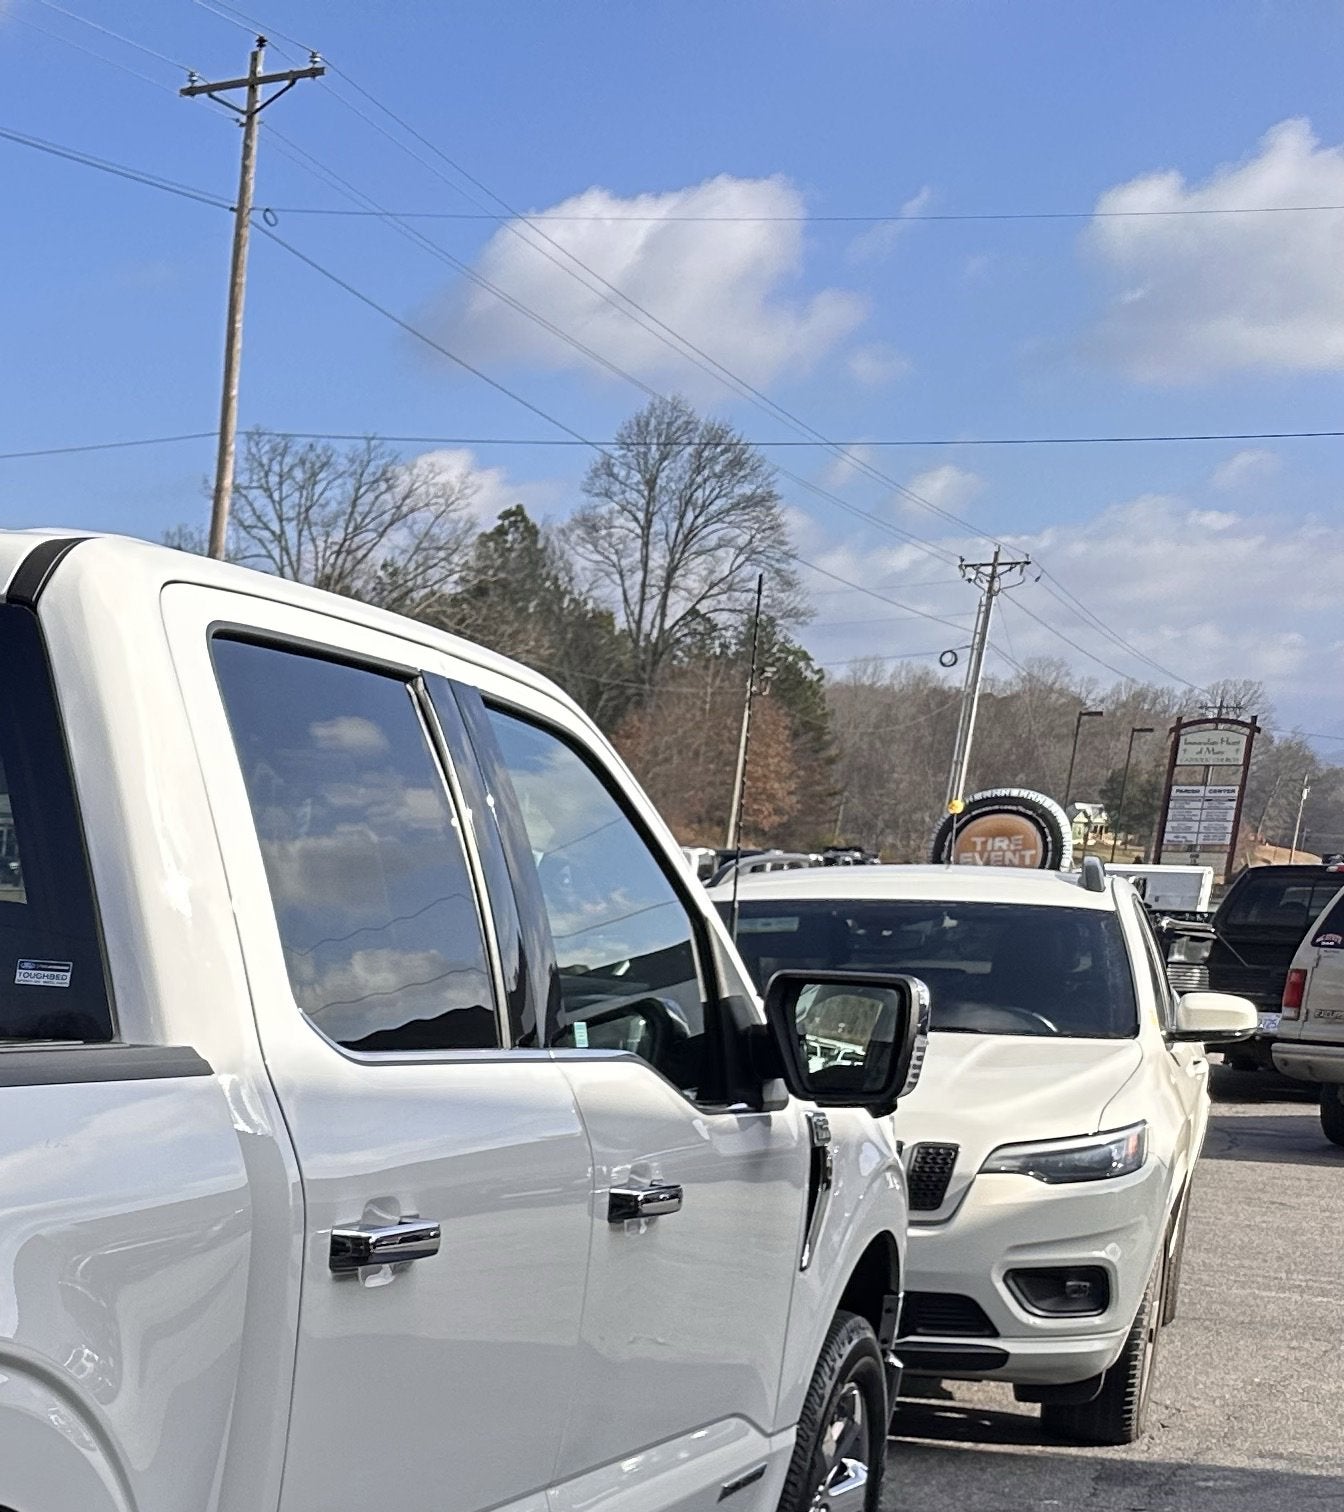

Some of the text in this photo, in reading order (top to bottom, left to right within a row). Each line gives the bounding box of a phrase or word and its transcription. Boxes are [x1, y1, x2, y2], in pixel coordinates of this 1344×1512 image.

[971, 834, 1024, 852] TIRE
[959, 849, 1036, 867] EVENT
[17, 971, 68, 982] TOUGHBED
